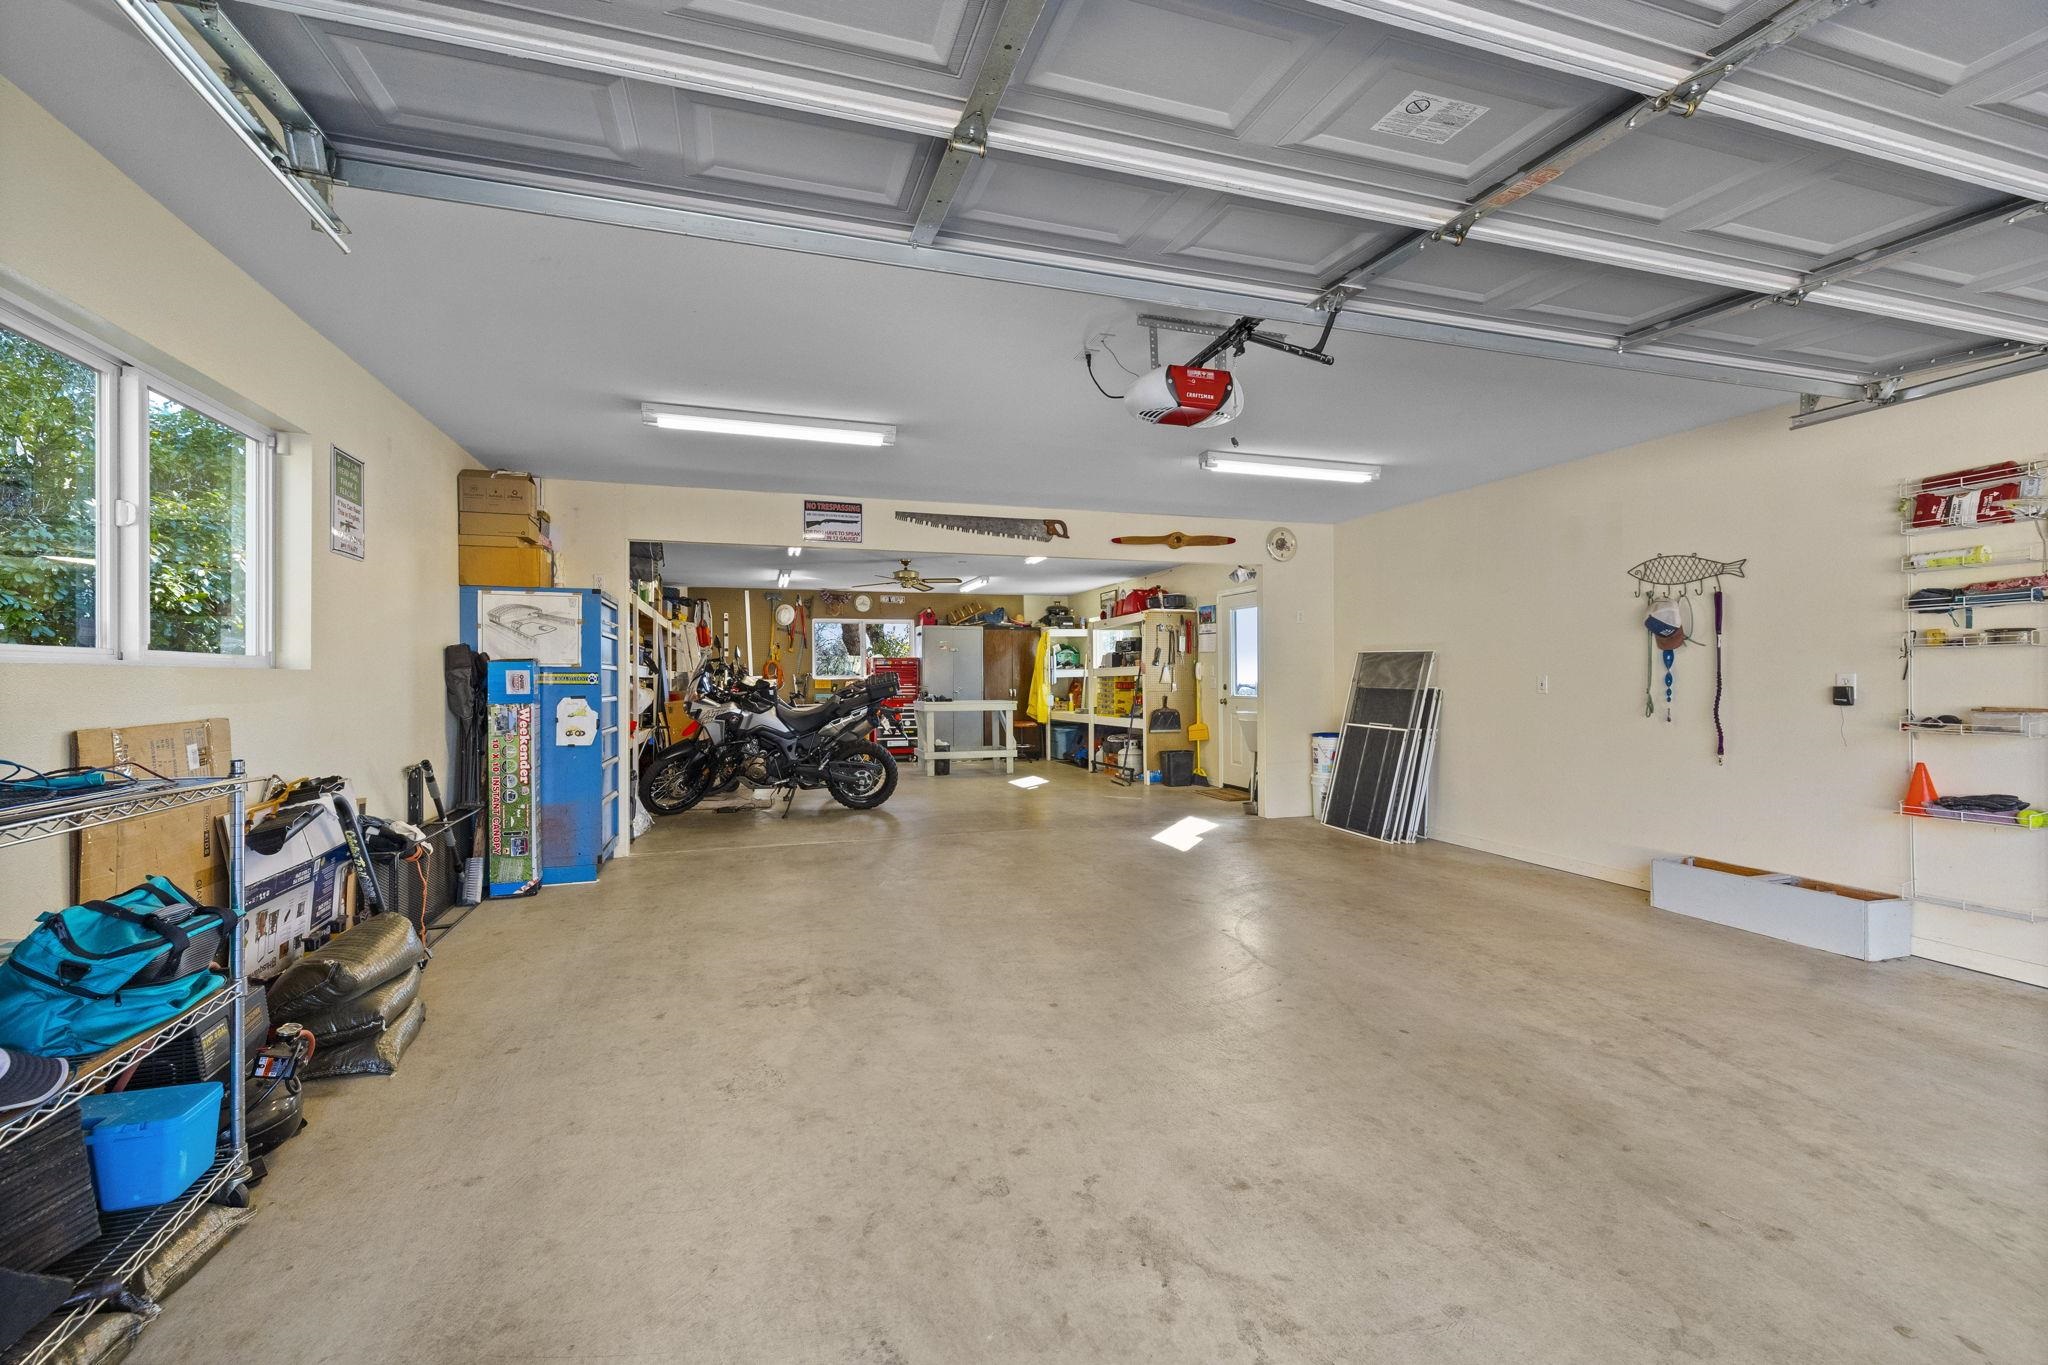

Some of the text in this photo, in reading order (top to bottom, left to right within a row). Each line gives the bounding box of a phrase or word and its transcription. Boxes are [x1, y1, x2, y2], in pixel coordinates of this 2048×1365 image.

[817, 503, 860, 512] TRESPASSING
[519, 706, 531, 784] Weekender
[492, 776, 500, 815] INSTANT
[492, 817, 501, 855] CANOPY
